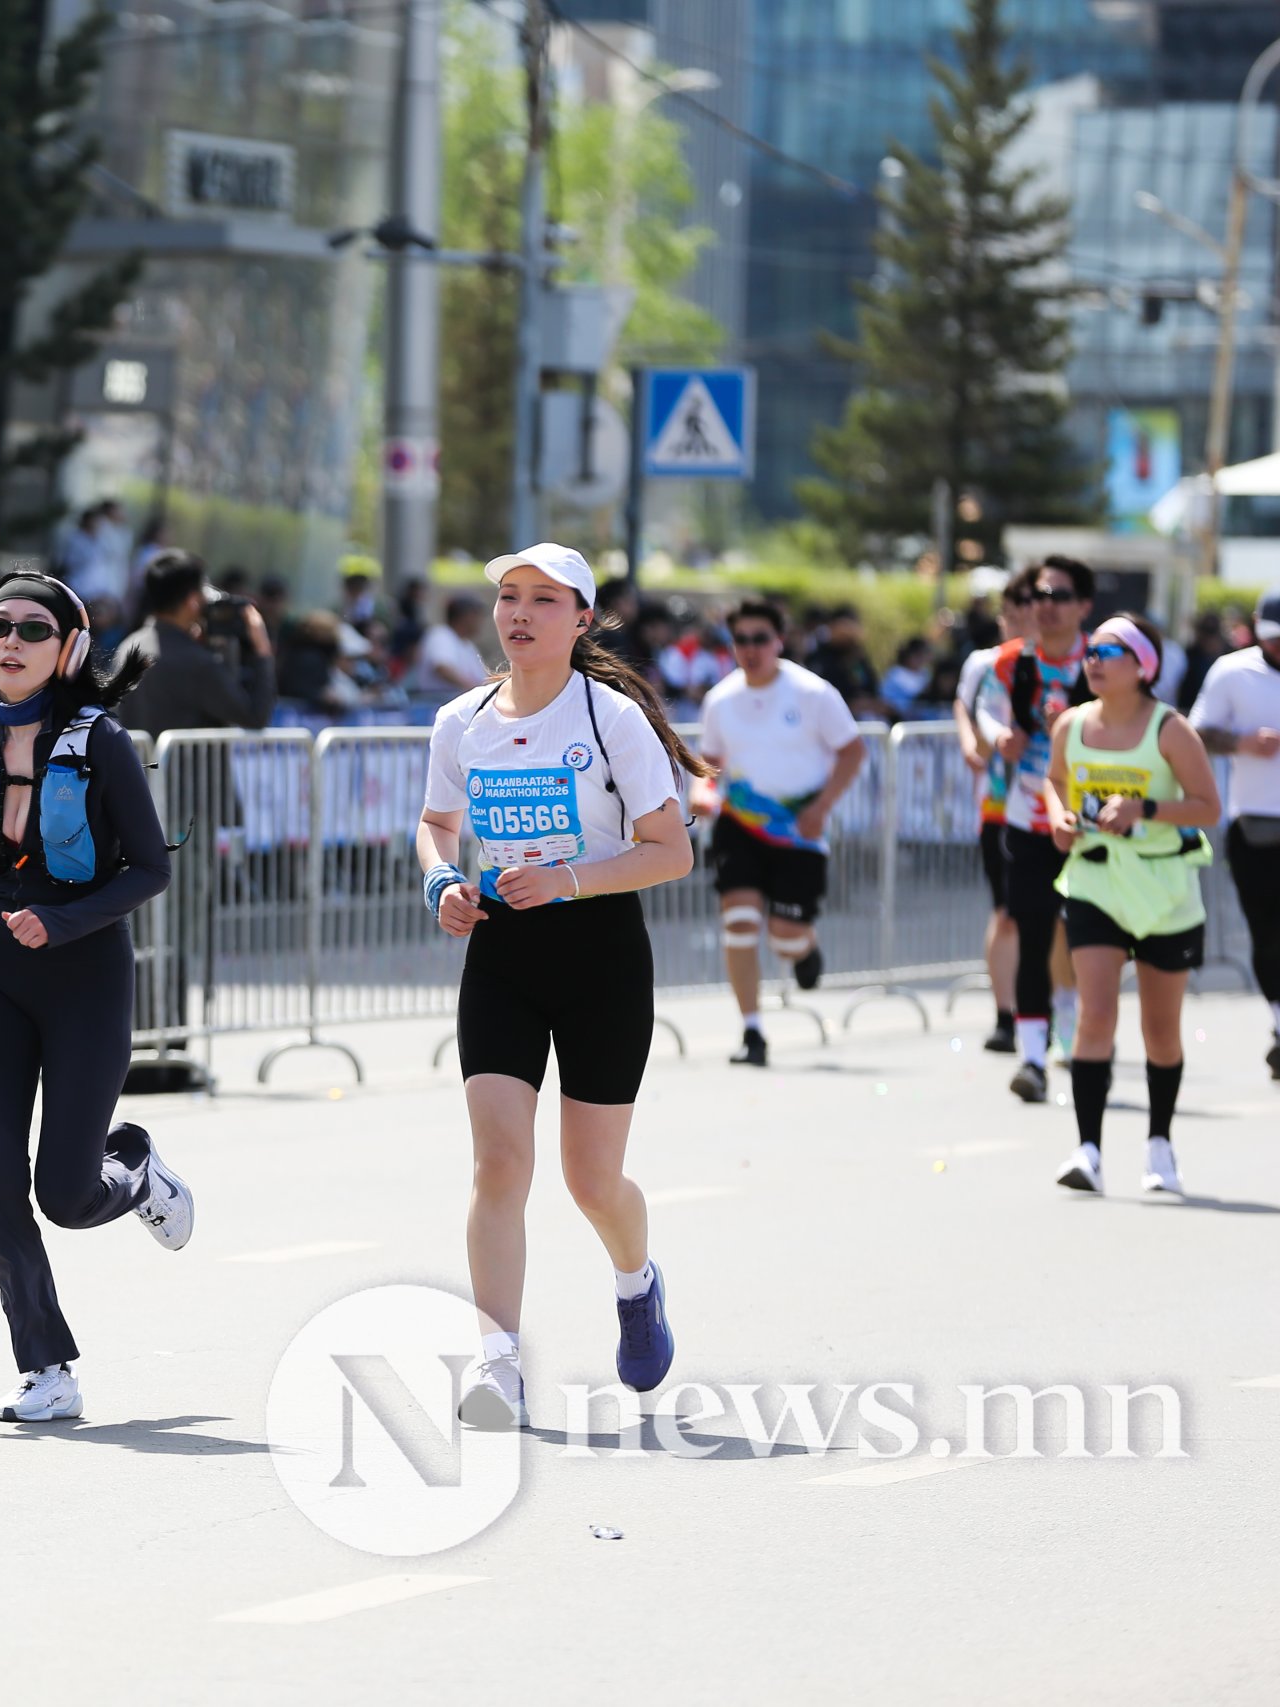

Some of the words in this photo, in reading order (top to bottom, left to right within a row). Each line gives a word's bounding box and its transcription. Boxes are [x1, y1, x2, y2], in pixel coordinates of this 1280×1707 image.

[484, 776, 556, 787] ULAANBAATAR
[485, 788, 541, 798] MARATHON
[542, 785, 569, 796] 2026
[489, 804, 570, 834] 05566
